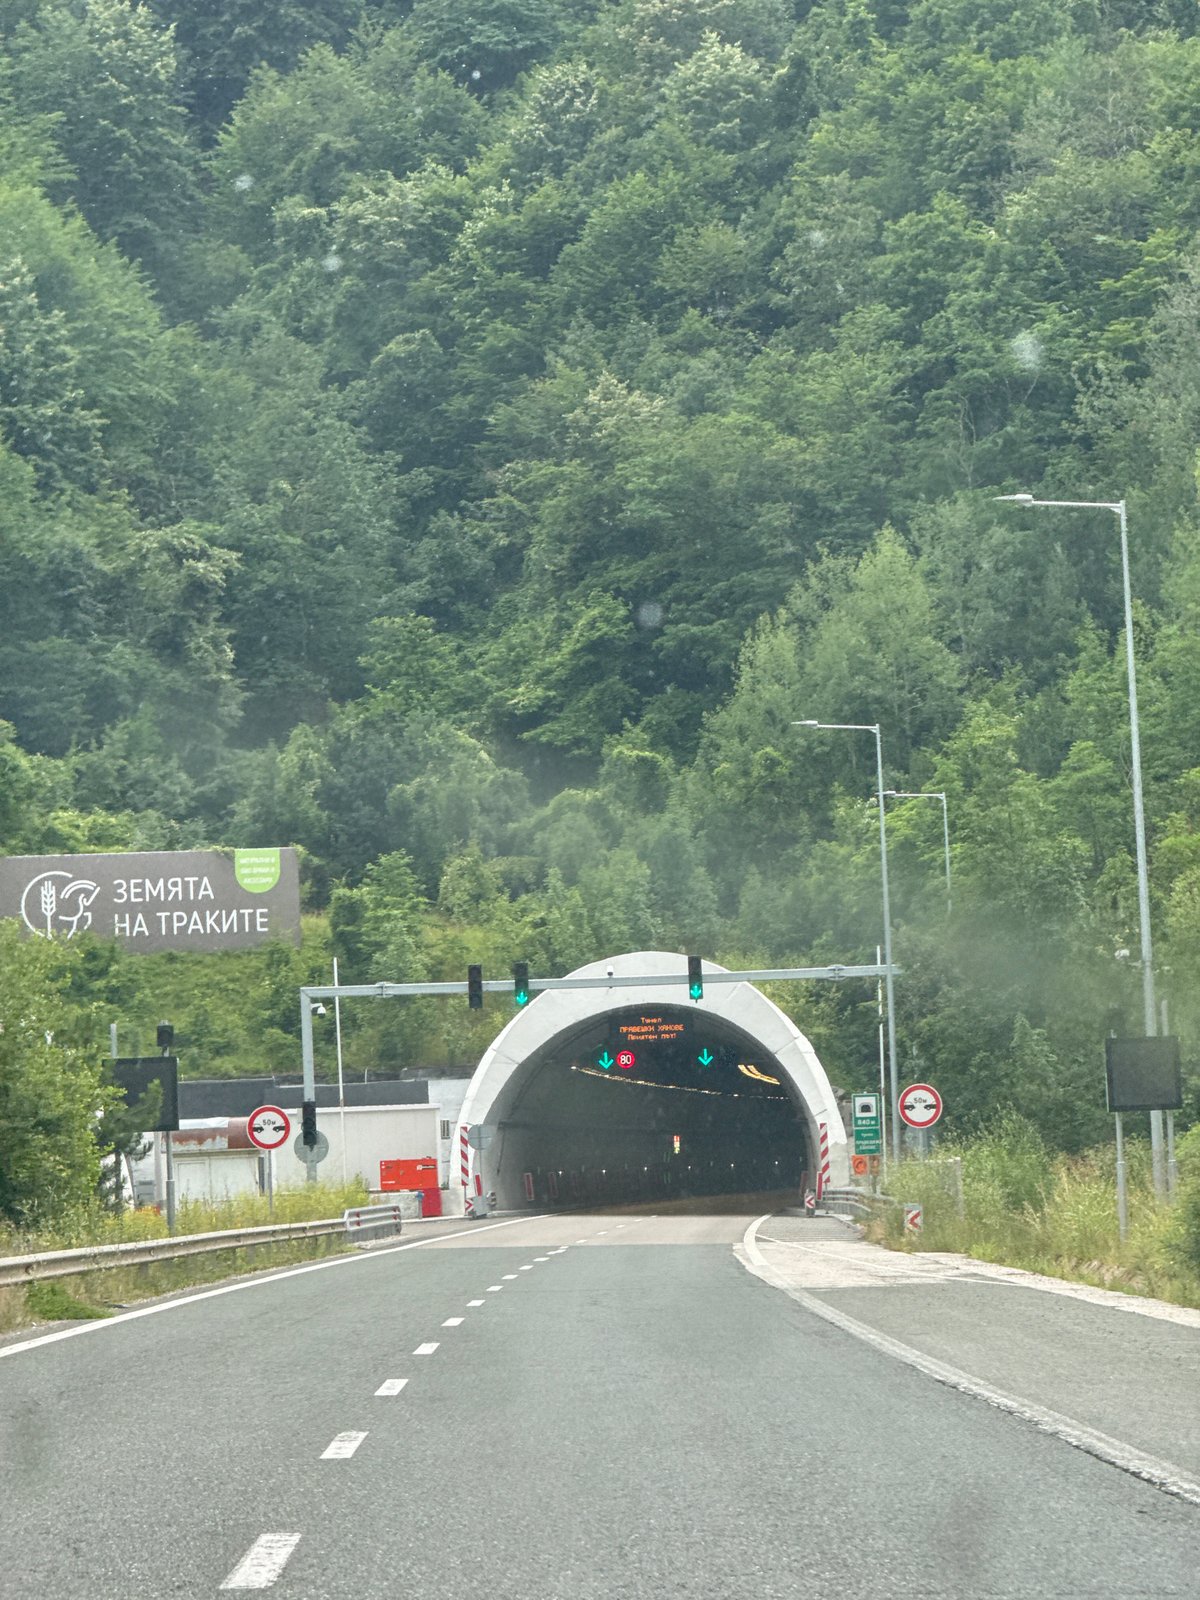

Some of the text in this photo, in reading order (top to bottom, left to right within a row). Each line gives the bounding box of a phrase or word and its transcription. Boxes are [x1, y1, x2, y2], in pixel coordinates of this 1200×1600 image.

[113, 877, 214, 903] ЗЕМЯТА
[114, 909, 268, 937] НА ТРАКИТЕ
[620, 1055, 632, 1065] 80
